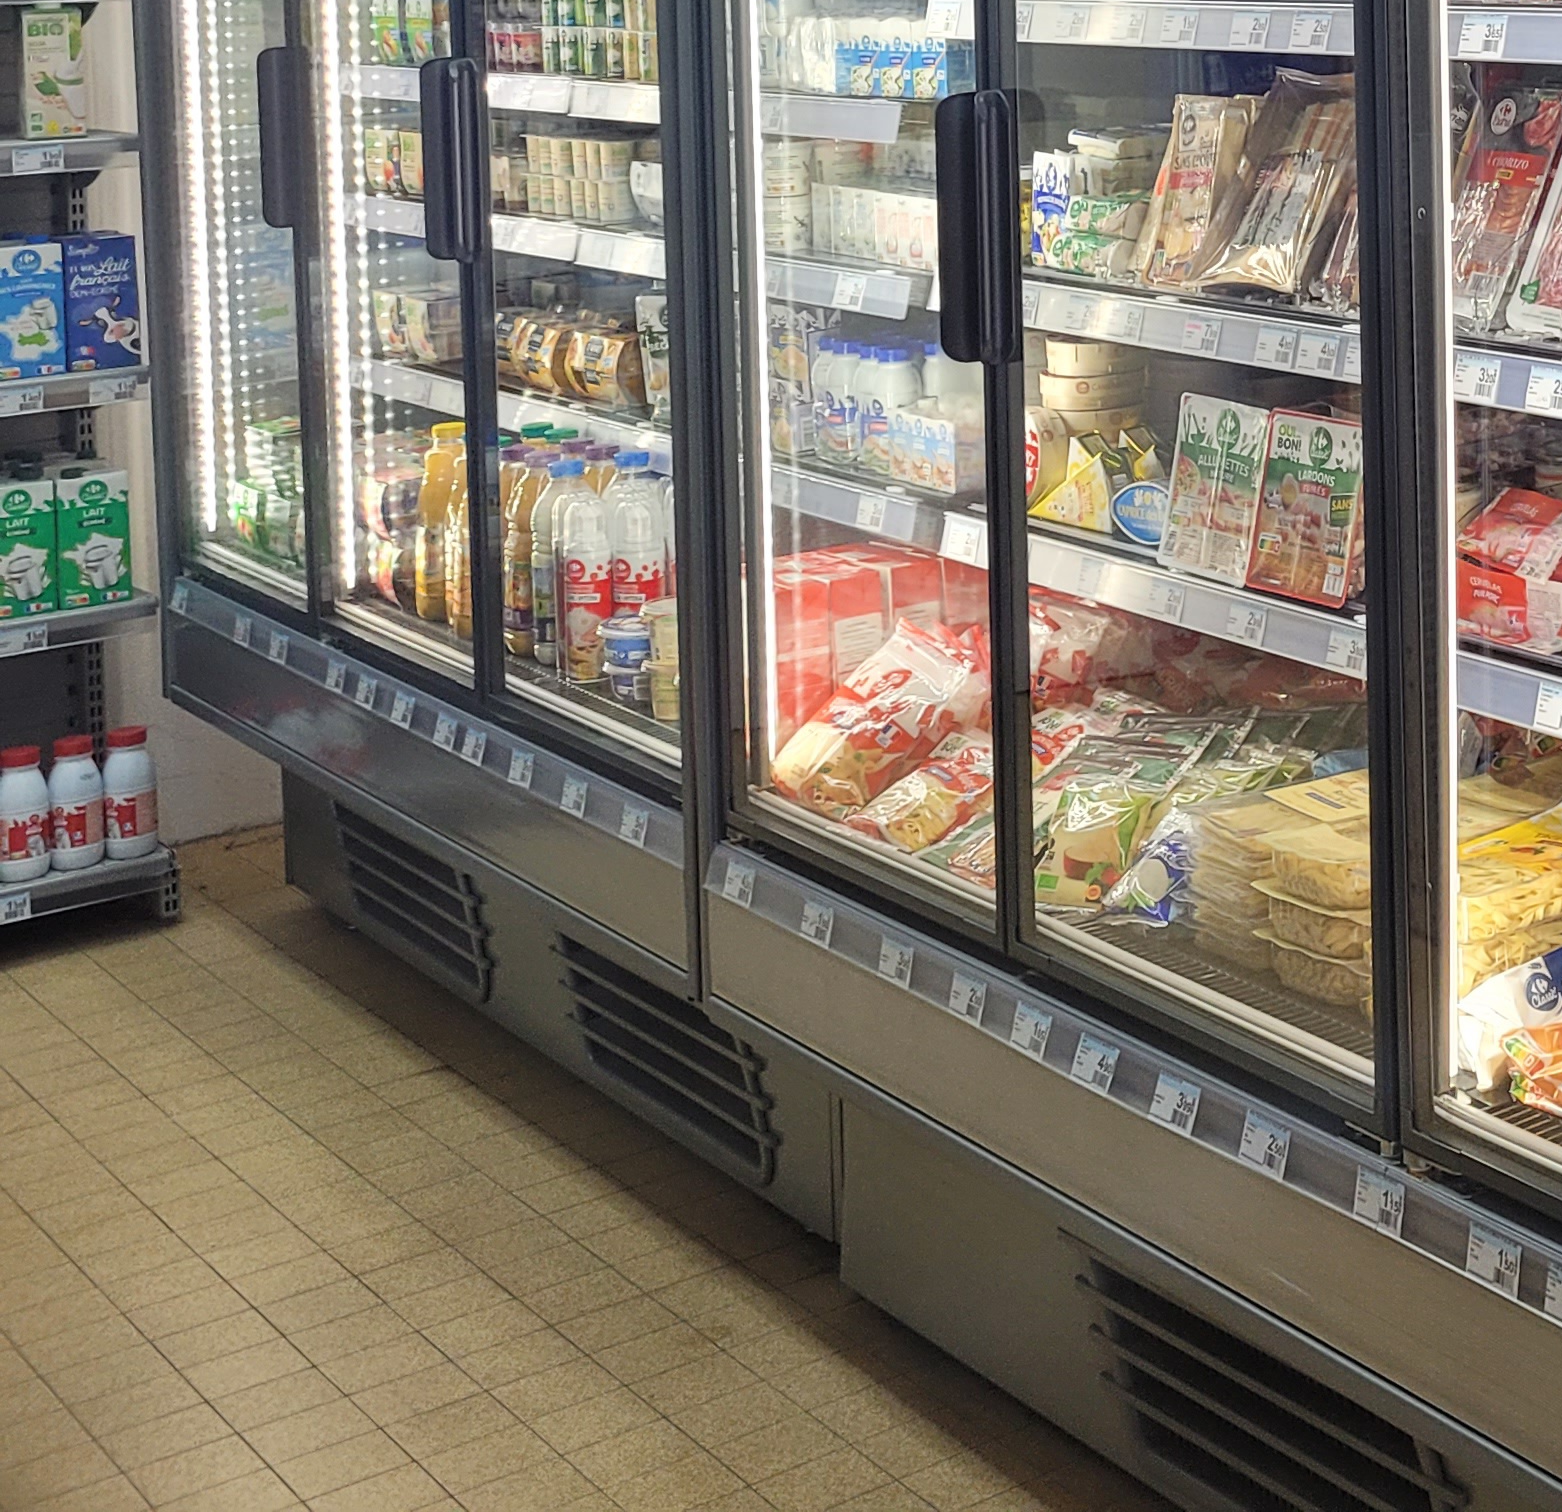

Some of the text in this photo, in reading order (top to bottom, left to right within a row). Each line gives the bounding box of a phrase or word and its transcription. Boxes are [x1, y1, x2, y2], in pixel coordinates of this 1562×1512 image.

[26, 23, 64, 38] BIO
[94, 256, 131, 276] Lait
[1297, 469, 1337, 487] LARDONS
[1331, 497, 1354, 512] SANS
